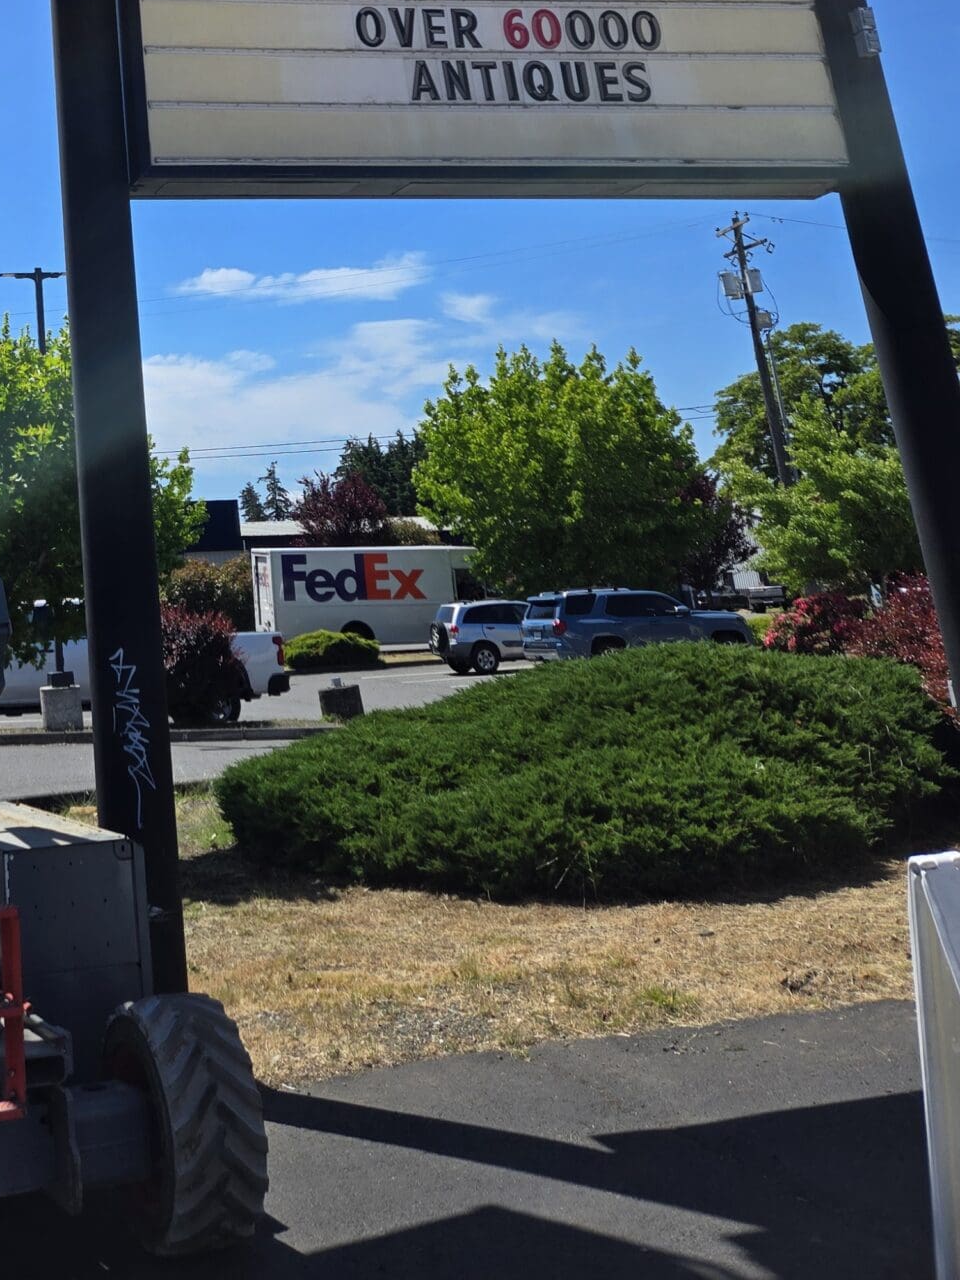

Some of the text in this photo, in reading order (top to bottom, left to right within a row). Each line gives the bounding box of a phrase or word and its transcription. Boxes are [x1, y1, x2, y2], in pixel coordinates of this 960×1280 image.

[355, 6, 662, 52] OVER 60000
[410, 59, 653, 104] ANTIQUES
[280, 553, 428, 602] FedEx
